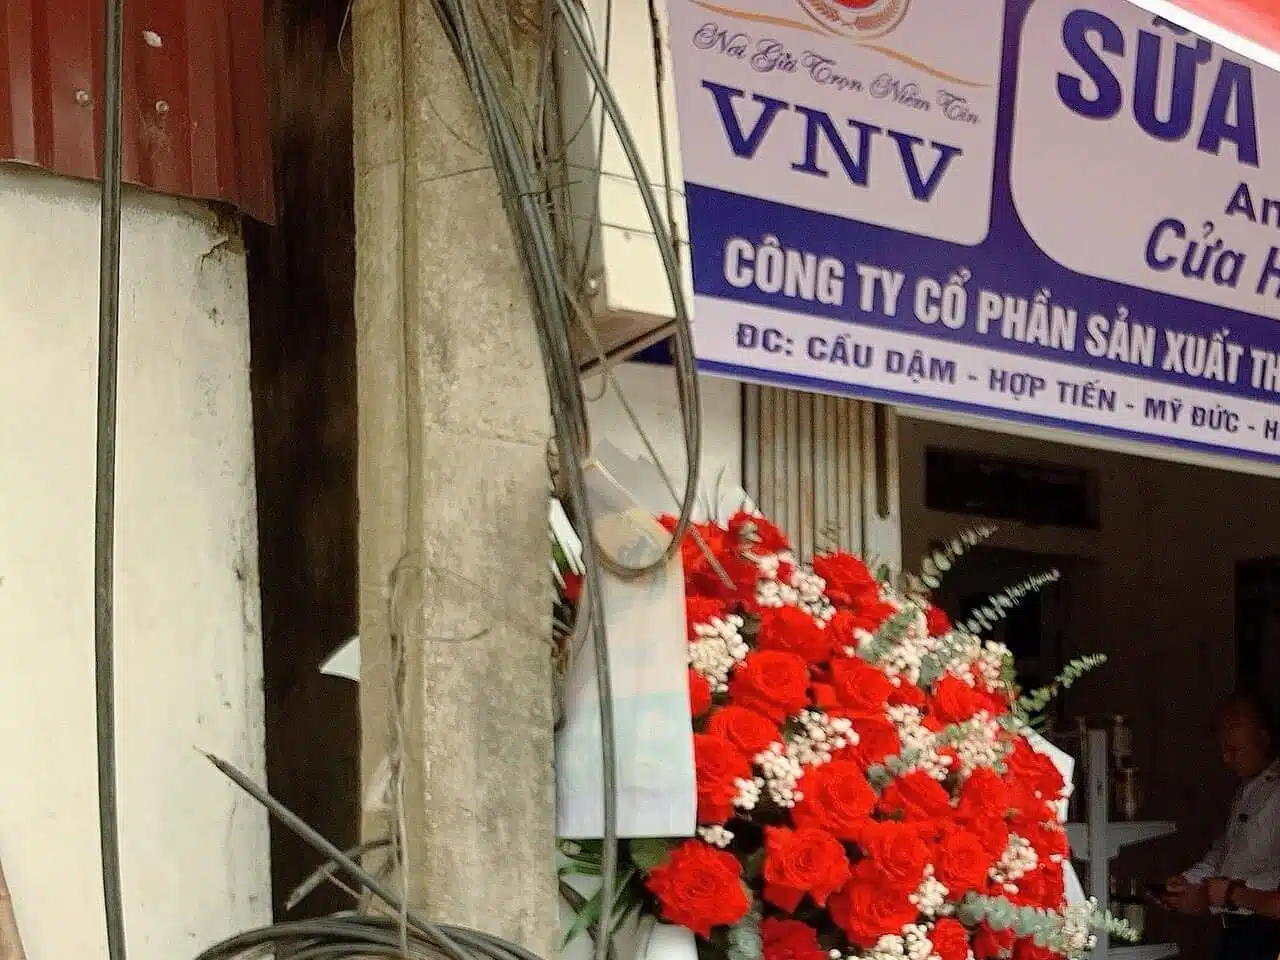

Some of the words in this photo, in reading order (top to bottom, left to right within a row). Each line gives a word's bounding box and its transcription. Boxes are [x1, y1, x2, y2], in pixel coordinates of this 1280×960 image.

[700, 79, 963, 203] VNV
[724, 234, 845, 306] CÔNG
[856, 264, 905, 317] TY
[914, 267, 971, 329] CỔ
[1085, 305, 1156, 368] SẢN
[1163, 328, 1243, 385] XUẤT
[1144, 217, 1246, 288] Cửa
[736, 322, 793, 356] ĐC:
[988, 366, 1047, 401] HỢP
[1056, 379, 1117, 413] TIẾN
[1144, 396, 1182, 423] MỸ
[1191, 402, 1239, 433] ĐỨC
